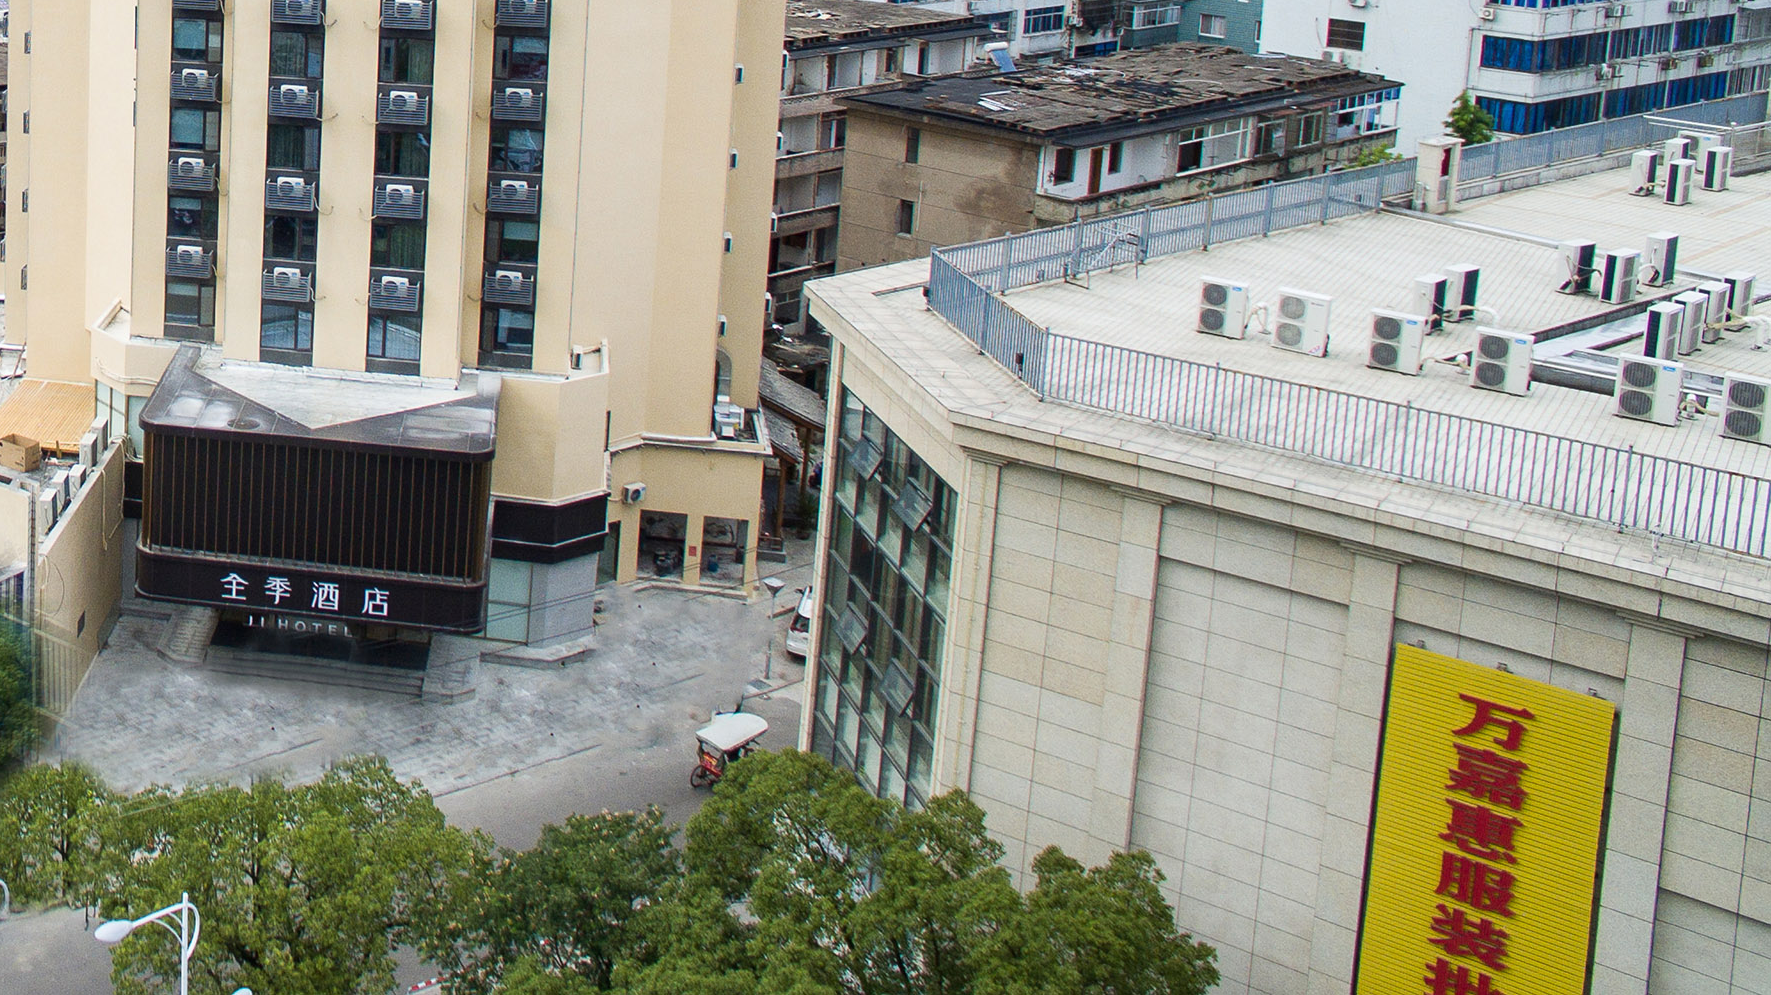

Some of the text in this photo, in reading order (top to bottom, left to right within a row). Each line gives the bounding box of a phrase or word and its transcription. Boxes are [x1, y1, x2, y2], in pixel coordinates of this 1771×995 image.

[220, 572, 390, 617] 全季酒店
[277, 617, 353, 638] HOTEL
